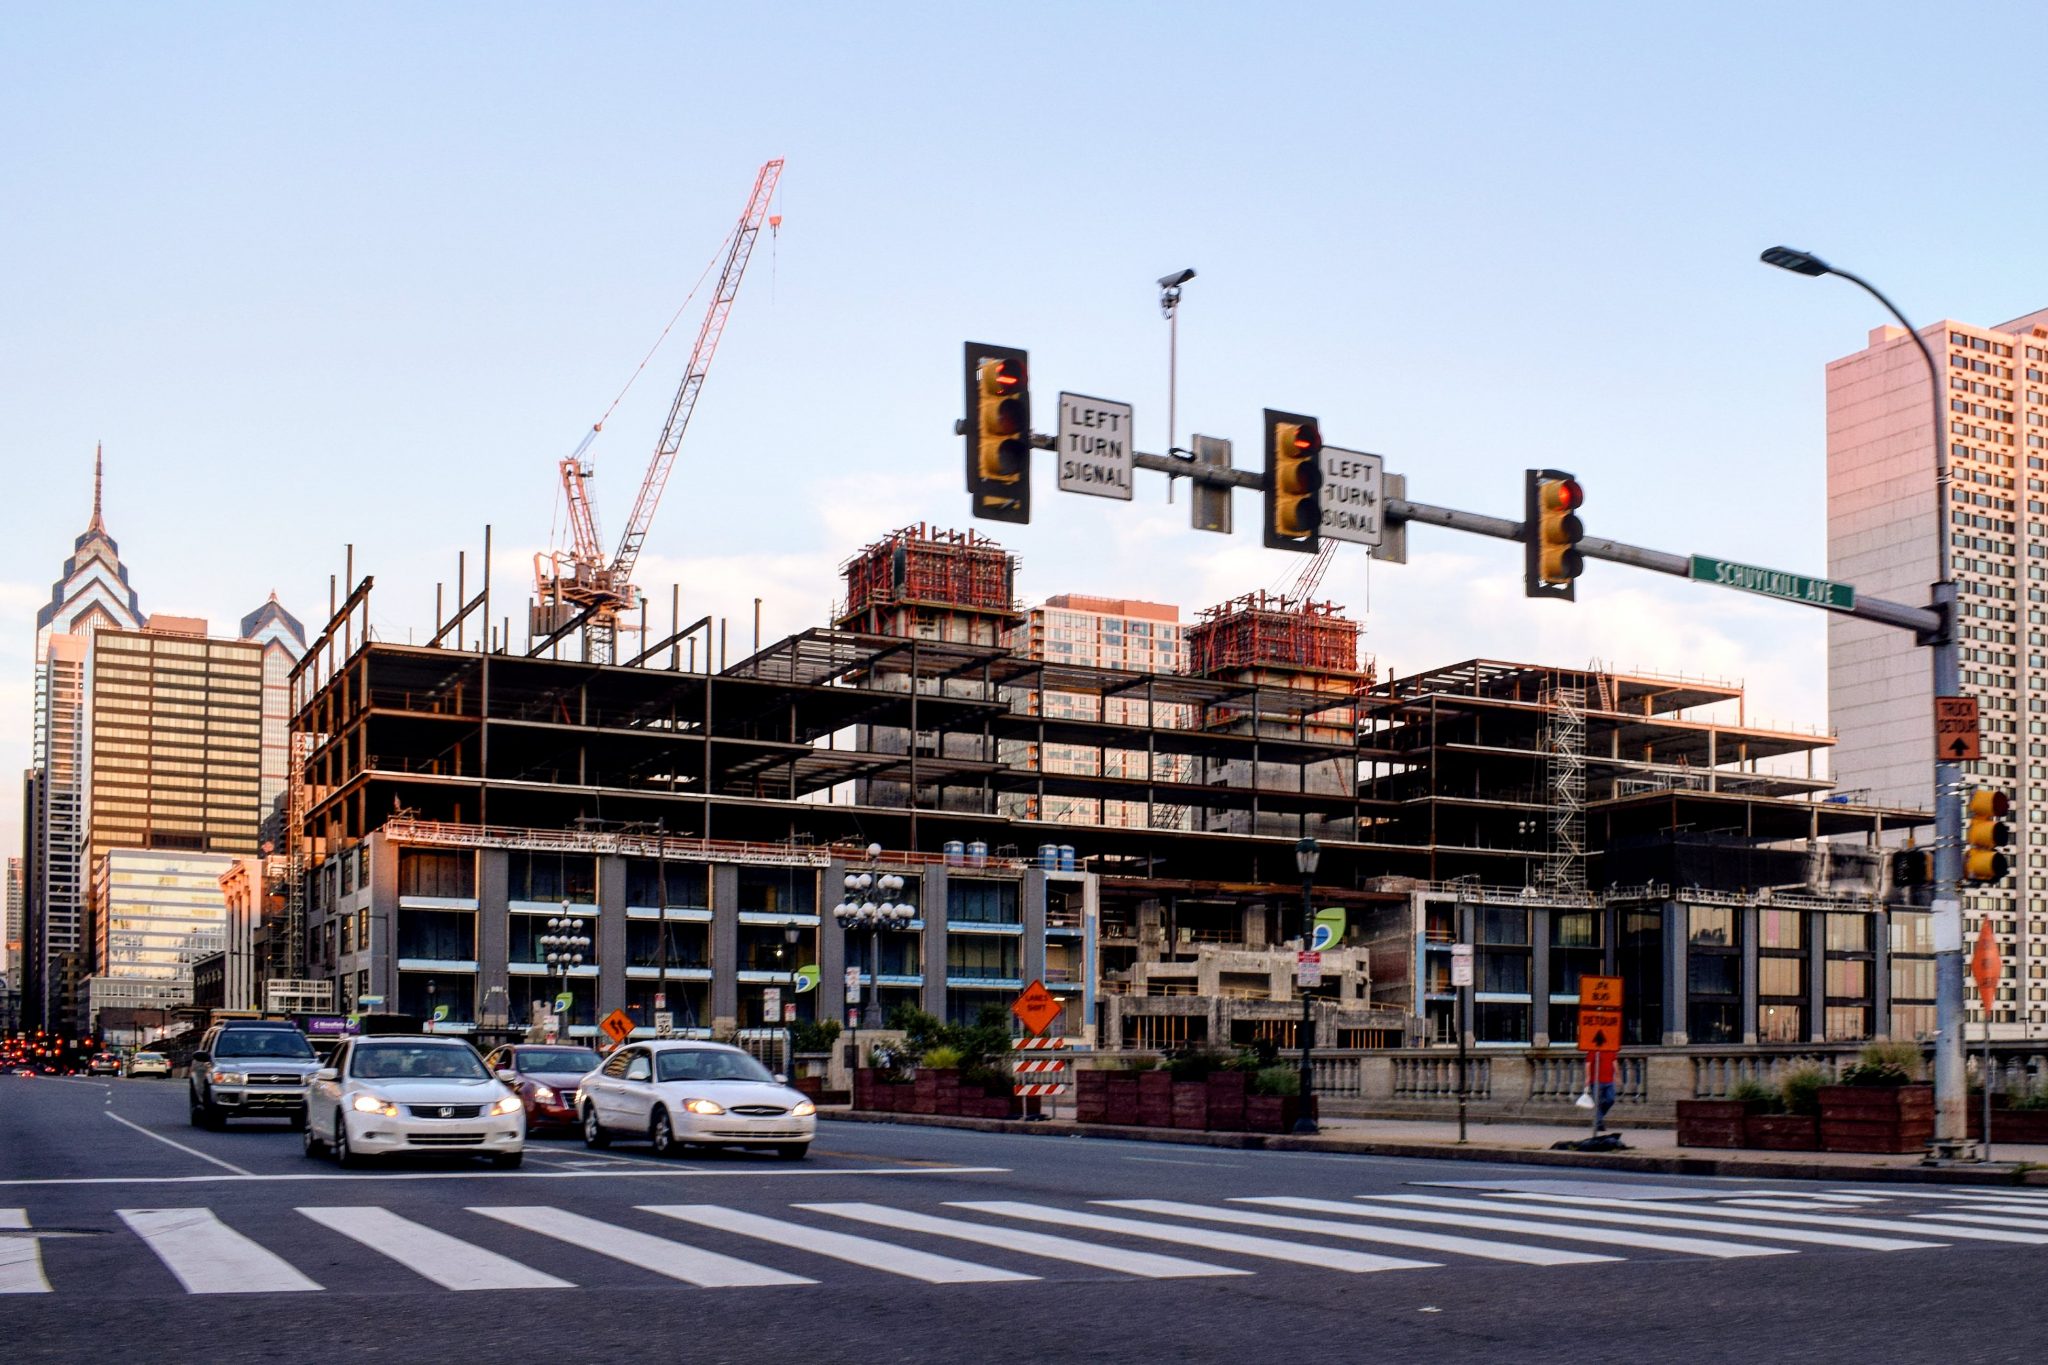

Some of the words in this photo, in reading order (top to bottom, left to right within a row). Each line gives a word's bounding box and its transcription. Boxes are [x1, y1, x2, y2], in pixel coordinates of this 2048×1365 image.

[1071, 406, 1120, 432] LEFT
[1068, 433, 1122, 459] TURN
[1063, 460, 1126, 487] SIGNAL
[1328, 459, 1373, 482] LEFT
[1326, 483, 1374, 507] TURN
[1323, 509, 1376, 534] SIGNAL
[1715, 561, 1800, 598] SCHUYLKILL
[1805, 580, 1833, 604] AVE
[1940, 702, 1972, 717] TRUCK
[1937, 719, 1978, 734] DETOUR
[658, 1025, 671, 1034] 30
[1583, 1015, 1619, 1027] DETOUR
